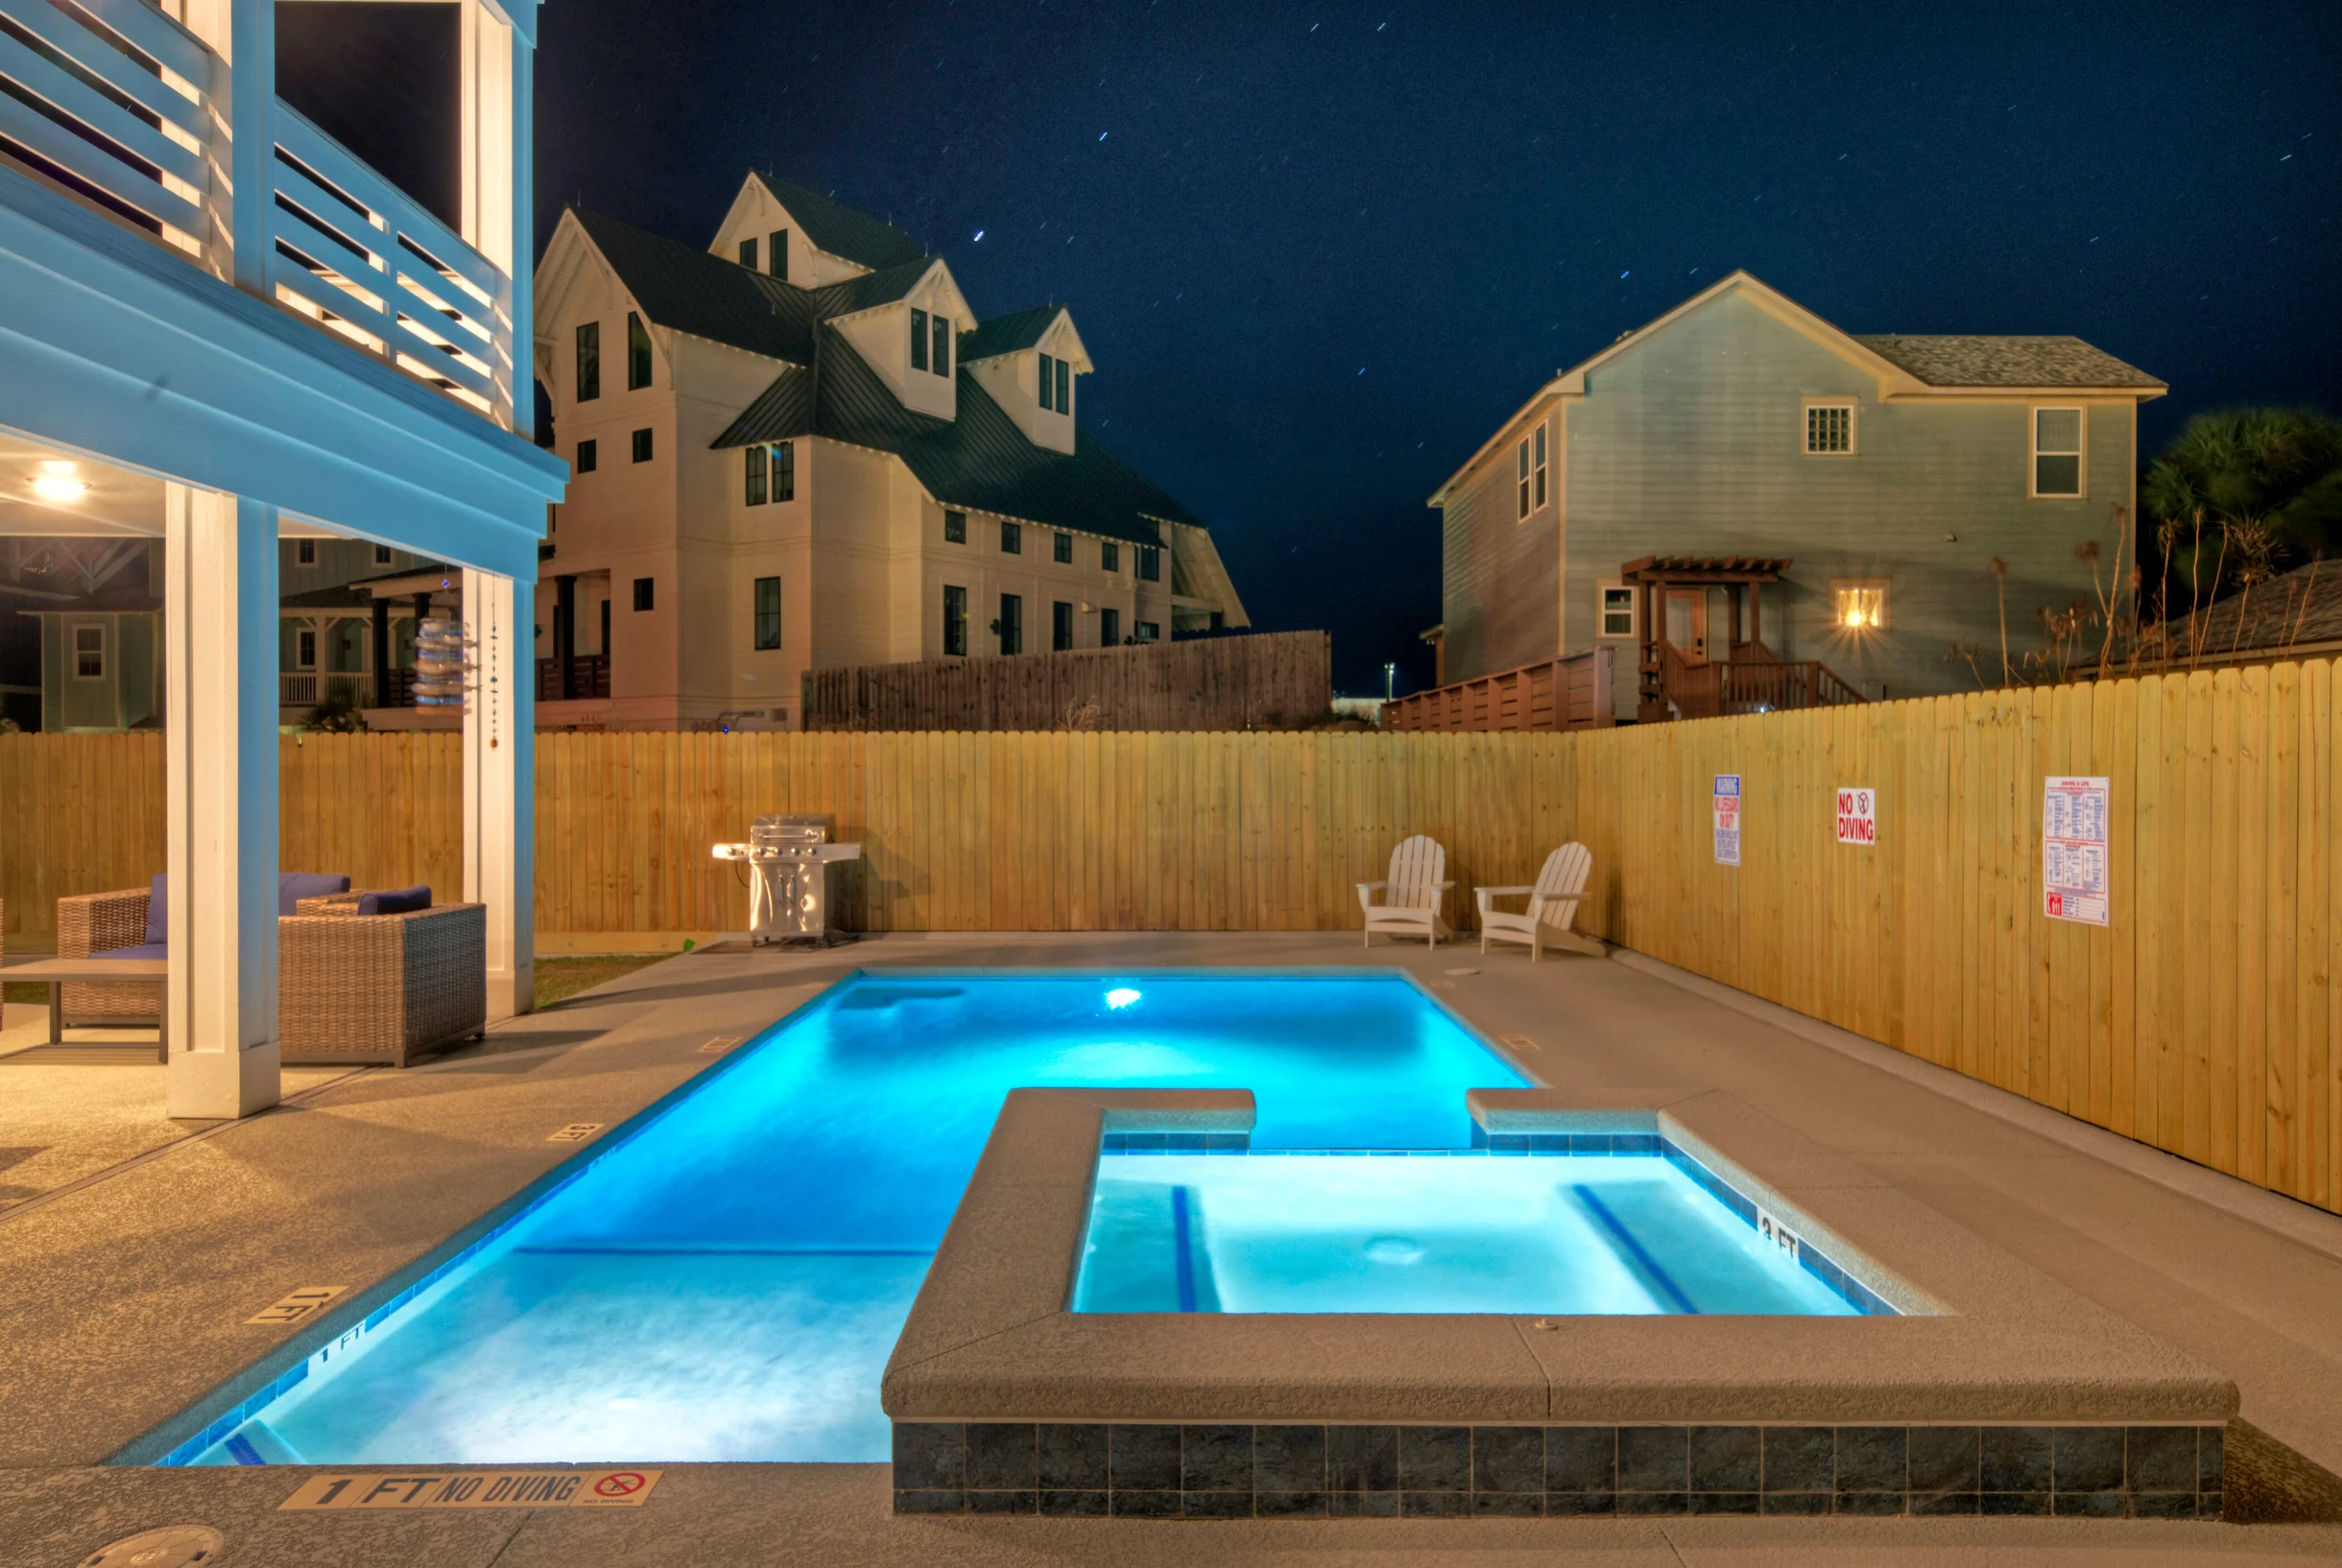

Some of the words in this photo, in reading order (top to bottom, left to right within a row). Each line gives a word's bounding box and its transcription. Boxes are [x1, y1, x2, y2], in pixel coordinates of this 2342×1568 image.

[1839, 793, 1852, 815] NO
[1839, 818, 1874, 841] DIVING
[2052, 900, 2061, 915] 911
[1779, 1227, 1796, 1259] FT
[257, 1305, 312, 1321] FT
[320, 1347, 328, 1363] 1
[341, 1323, 363, 1350] FT
[316, 1479, 353, 1504] 1
[361, 1478, 442, 1504] FT
[434, 1477, 483, 1502] NO
[482, 1476, 581, 1502] DIVING
